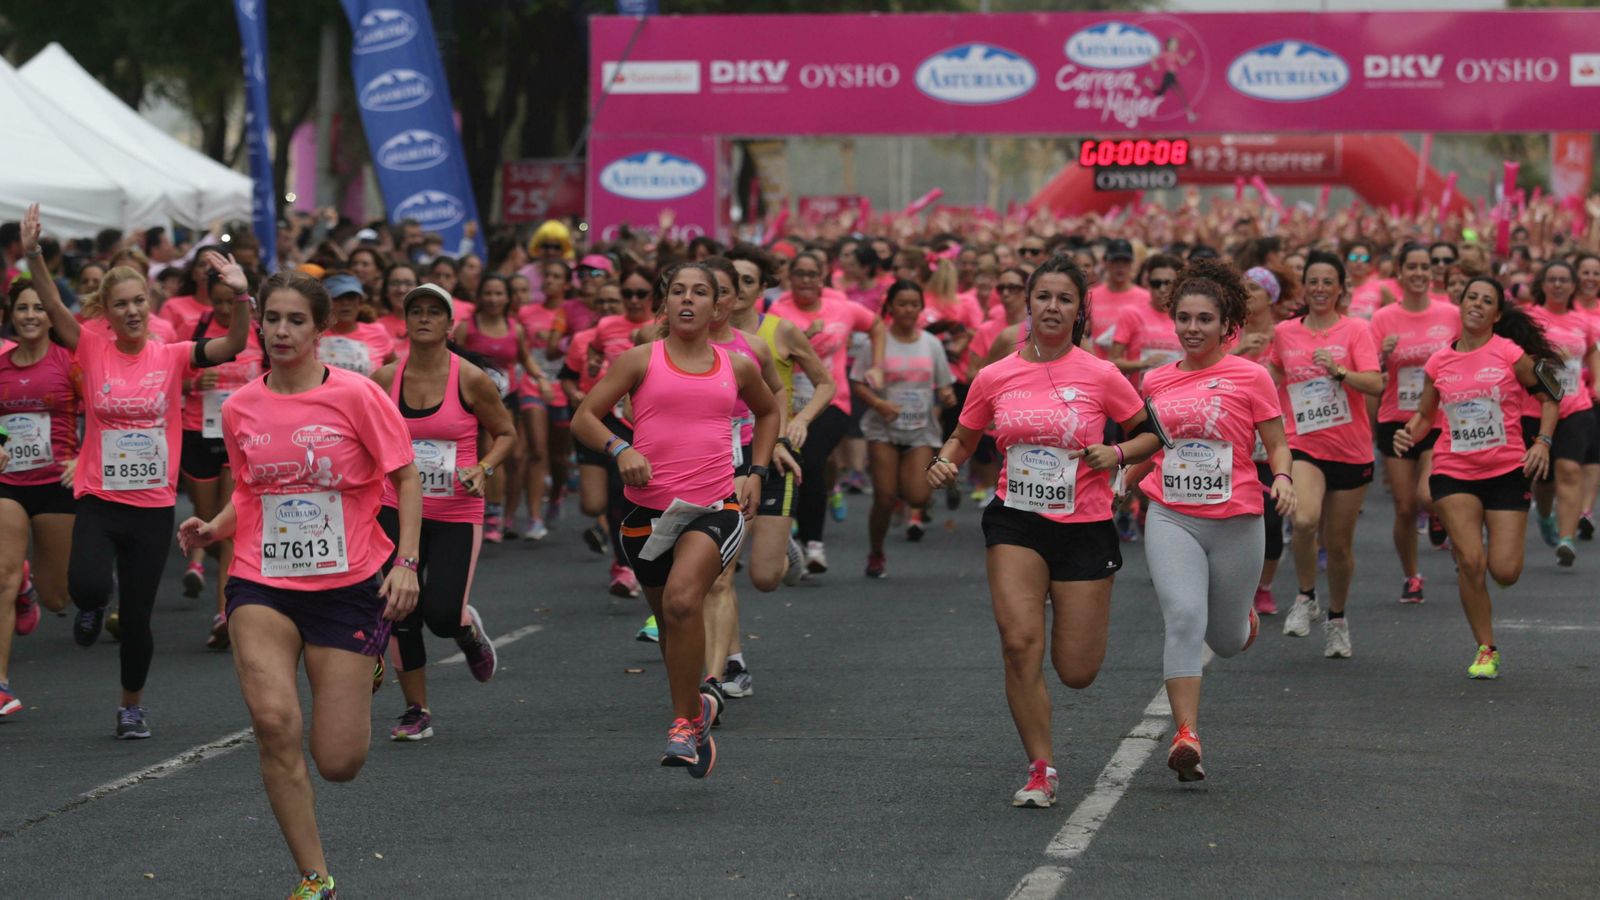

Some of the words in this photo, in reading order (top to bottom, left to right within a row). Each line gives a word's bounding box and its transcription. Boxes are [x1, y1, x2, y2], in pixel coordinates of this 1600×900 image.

[1076, 41, 1152, 56] ASTURIANA
[709, 59, 789, 84] DKV
[799, 63, 900, 89] OYSHO
[1243, 64, 1341, 86] ASTURIANA
[1363, 54, 1444, 78] DKV
[1456, 57, 1559, 83] OYSHO
[929, 66, 1027, 88] ASTURIANA
[1055, 64, 1141, 97] Carrera
[1101, 90, 1165, 128] Mujer
[1255, 151, 1326, 172] correr
[611, 170, 697, 188] ASTURIANA
[999, 408, 1065, 428] ARRERA
[1307, 402, 1339, 421] 8465
[296, 432, 340, 443] ASTURIANA
[1462, 425, 1494, 440] 8464
[120, 462, 157, 477] 8536
[1024, 455, 1057, 467] ASTURIANA
[1018, 481, 1066, 500] 11936
[1174, 475, 1223, 490] 11934
[279, 508, 318, 519] ASTURIANA
[280, 538, 329, 559] 7613
